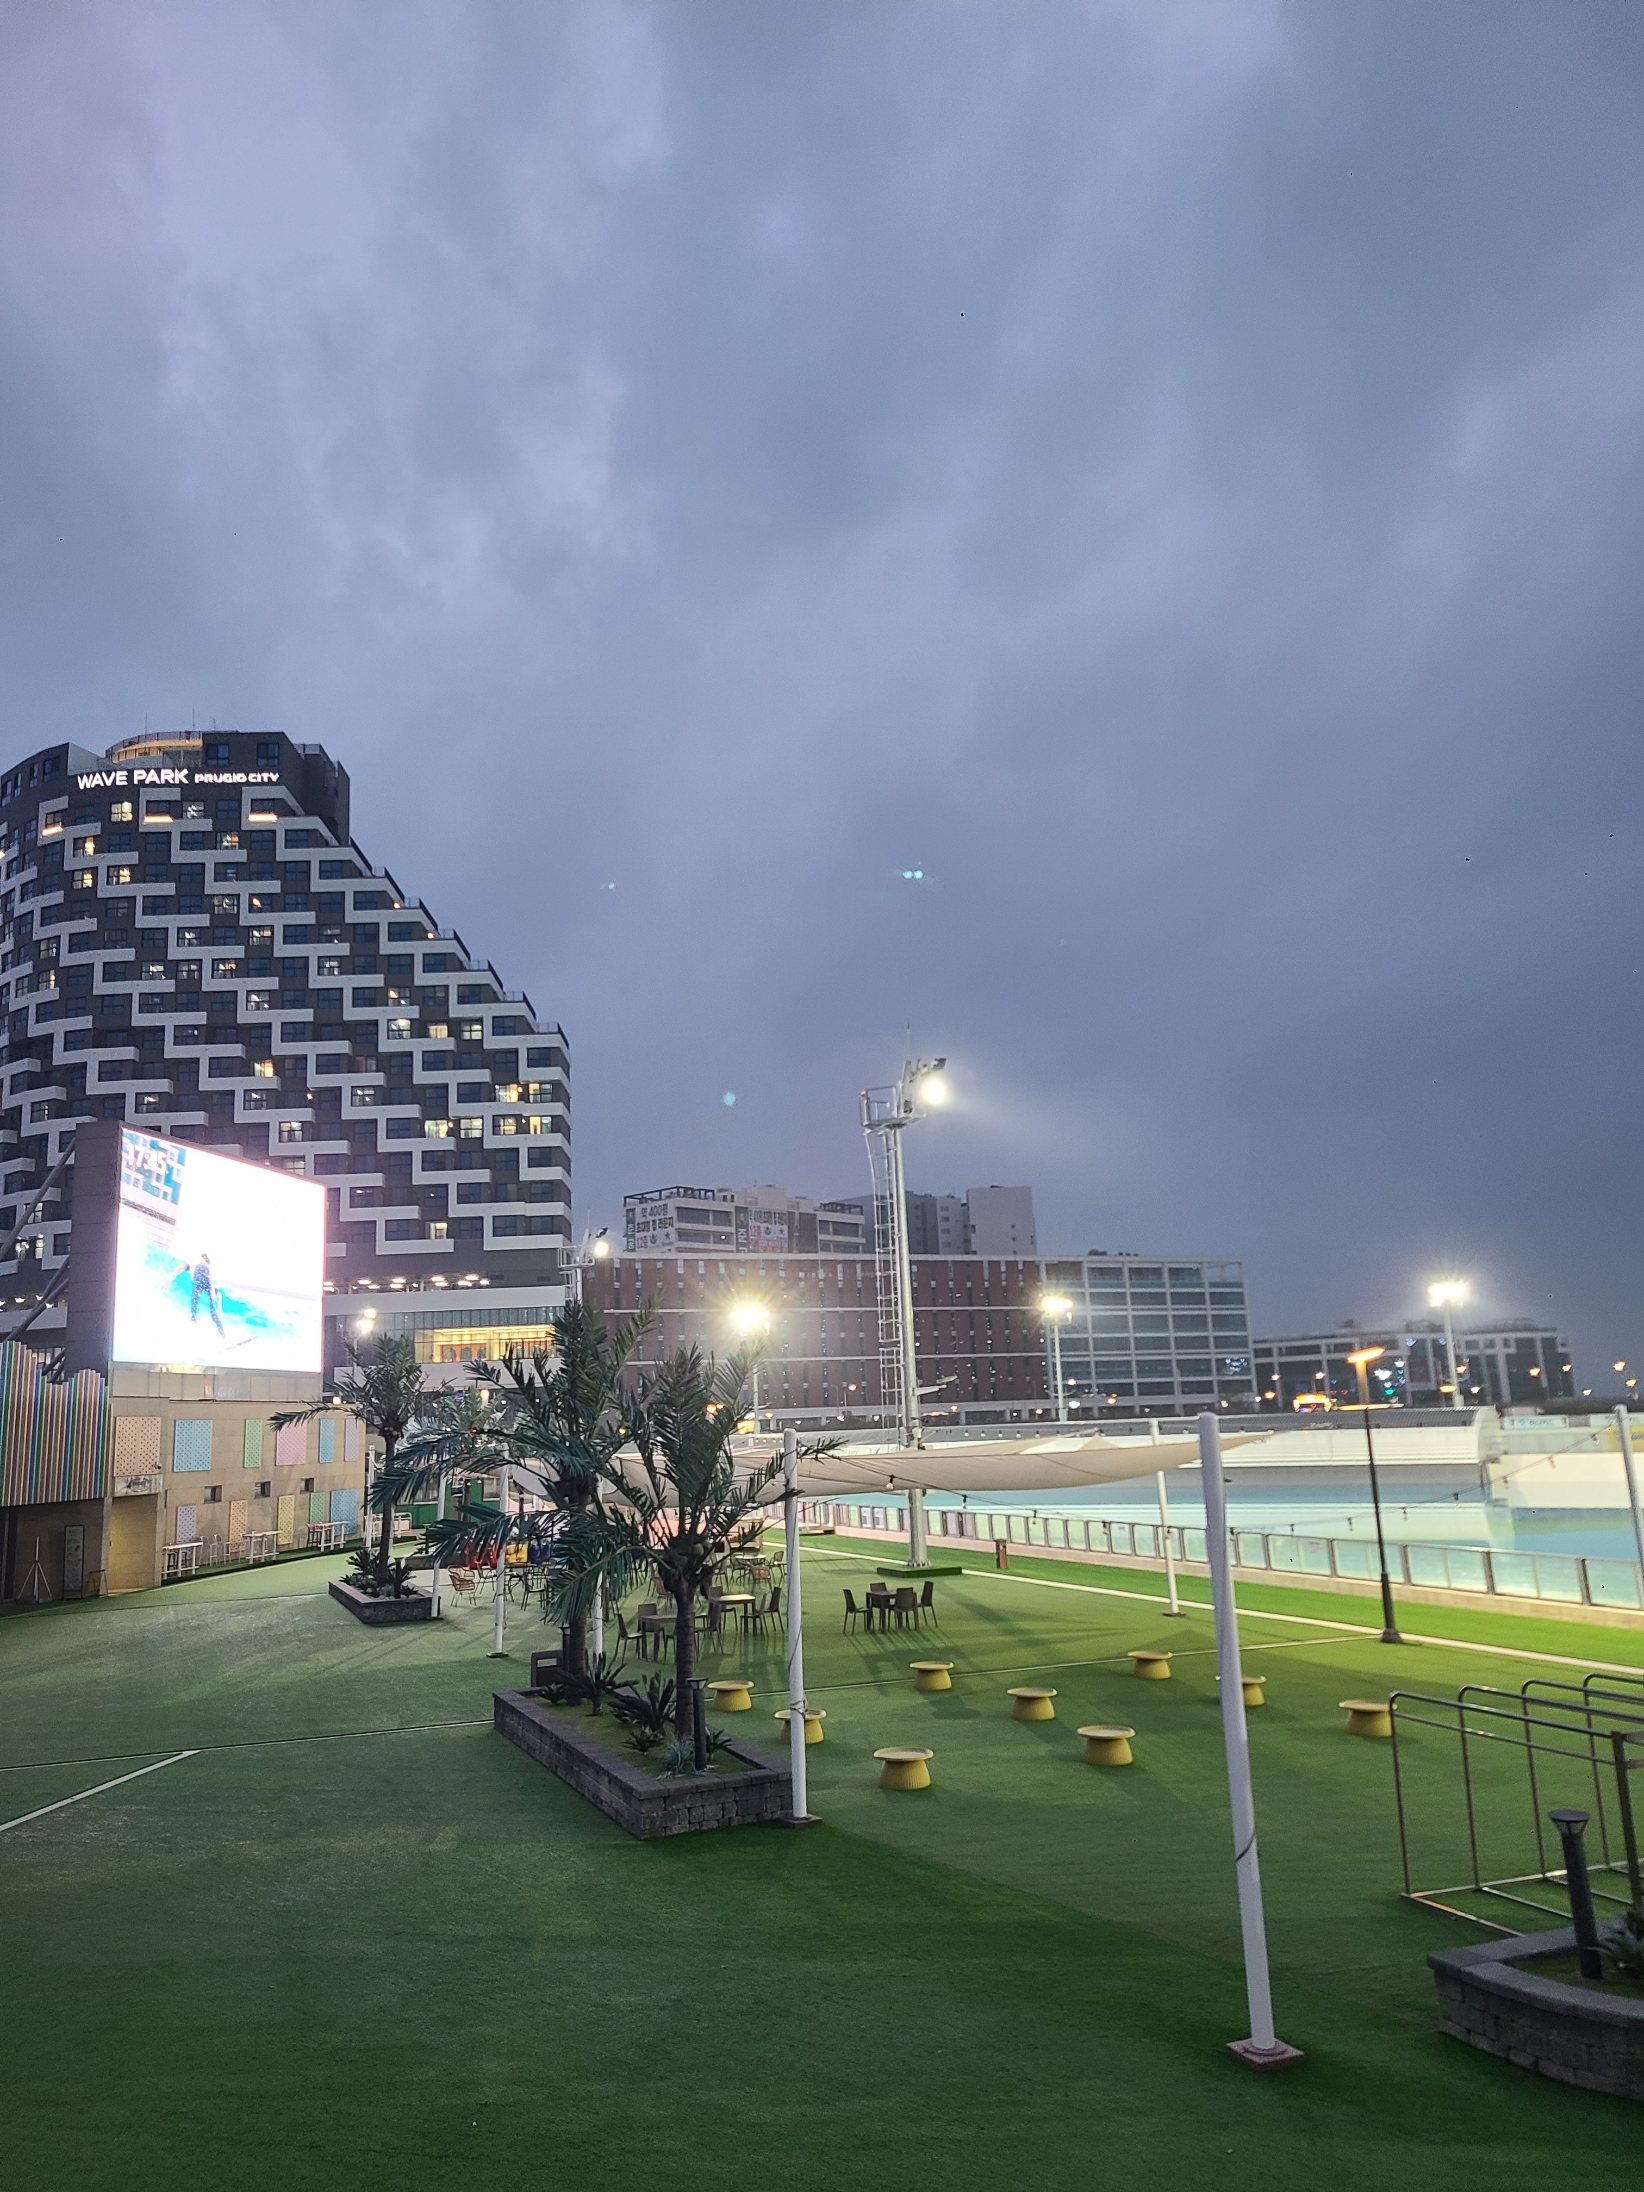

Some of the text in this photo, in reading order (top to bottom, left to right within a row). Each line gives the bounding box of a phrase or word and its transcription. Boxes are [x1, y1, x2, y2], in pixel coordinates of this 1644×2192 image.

[77, 770, 128, 790] WAVE
[133, 768, 190, 785] PARK
[248, 772, 280, 783] CITY
